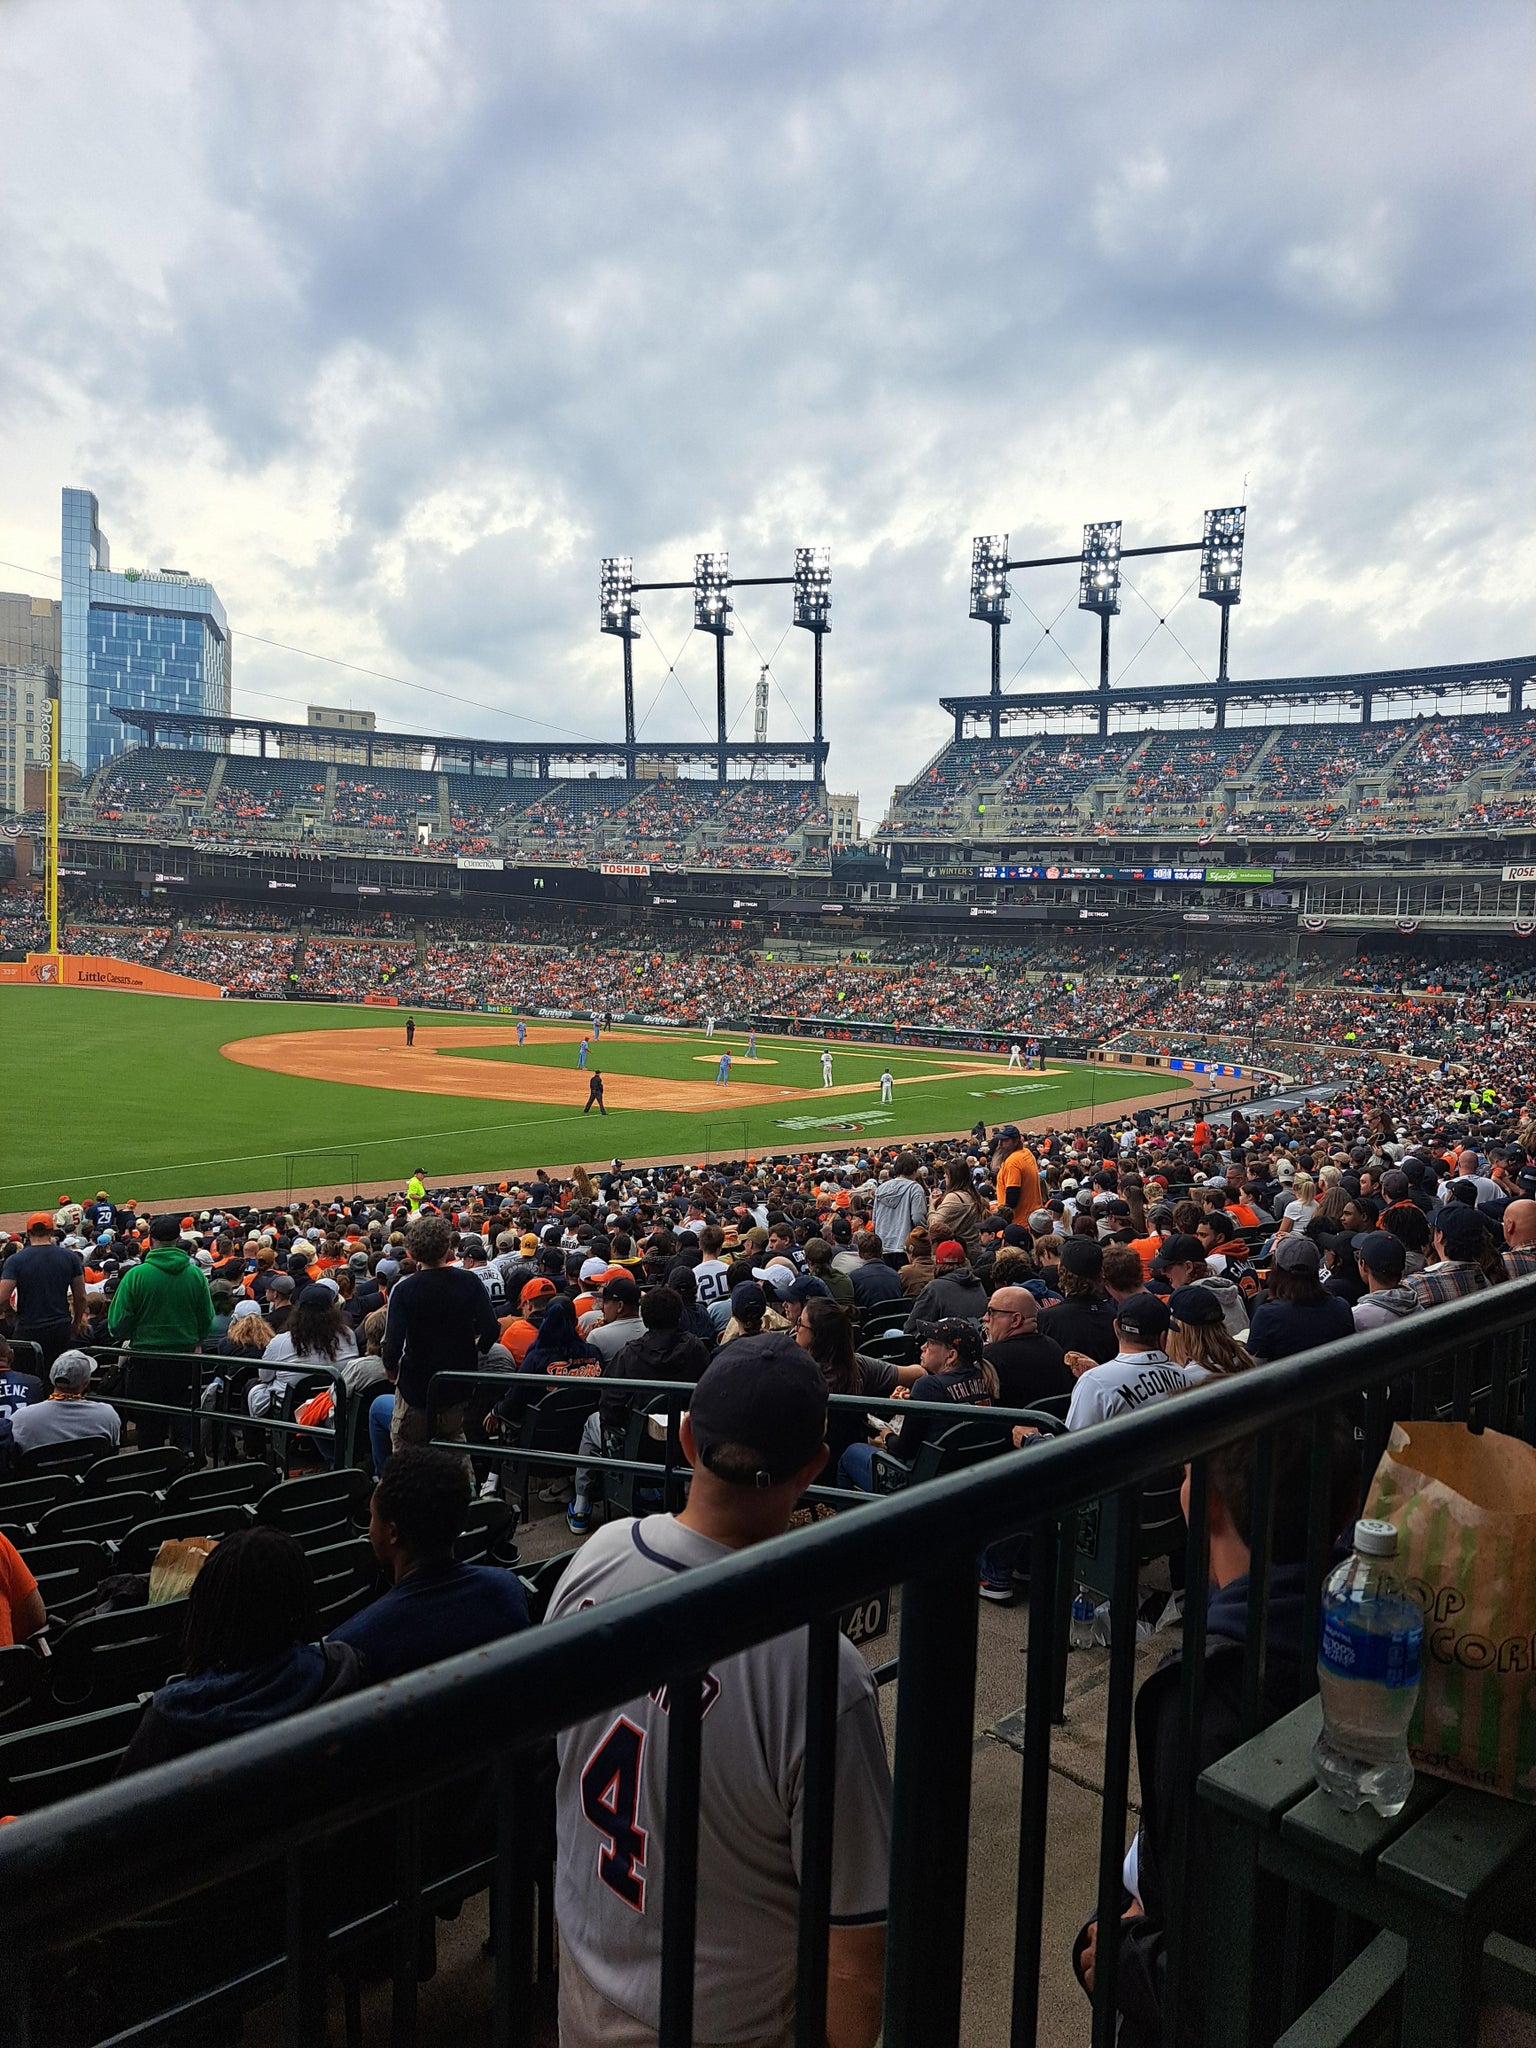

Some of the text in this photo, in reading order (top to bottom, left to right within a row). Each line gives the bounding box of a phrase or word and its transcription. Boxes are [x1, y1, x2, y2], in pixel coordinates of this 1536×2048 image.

[142, 569, 207, 588] Huntington
[41, 711, 53, 769] Rocket
[603, 864, 648, 875] TOSHIBA
[939, 866, 974, 877] WINTER'S
[1508, 866, 1536, 880] ROSE
[78, 971, 143, 986] Little Caesars.com
[487, 1005, 512, 1014] bet365
[539, 1008, 574, 1018] Dunham's
[643, 1015, 680, 1026] Dunham's
[72, 1213, 80, 1225] 5
[97, 1212, 112, 1224] 29
[697, 1270, 729, 1300] 20
[846, 1600, 881, 1640] 40
[1430, 1627, 1536, 1673] COR
[580, 1714, 648, 1914] 4
